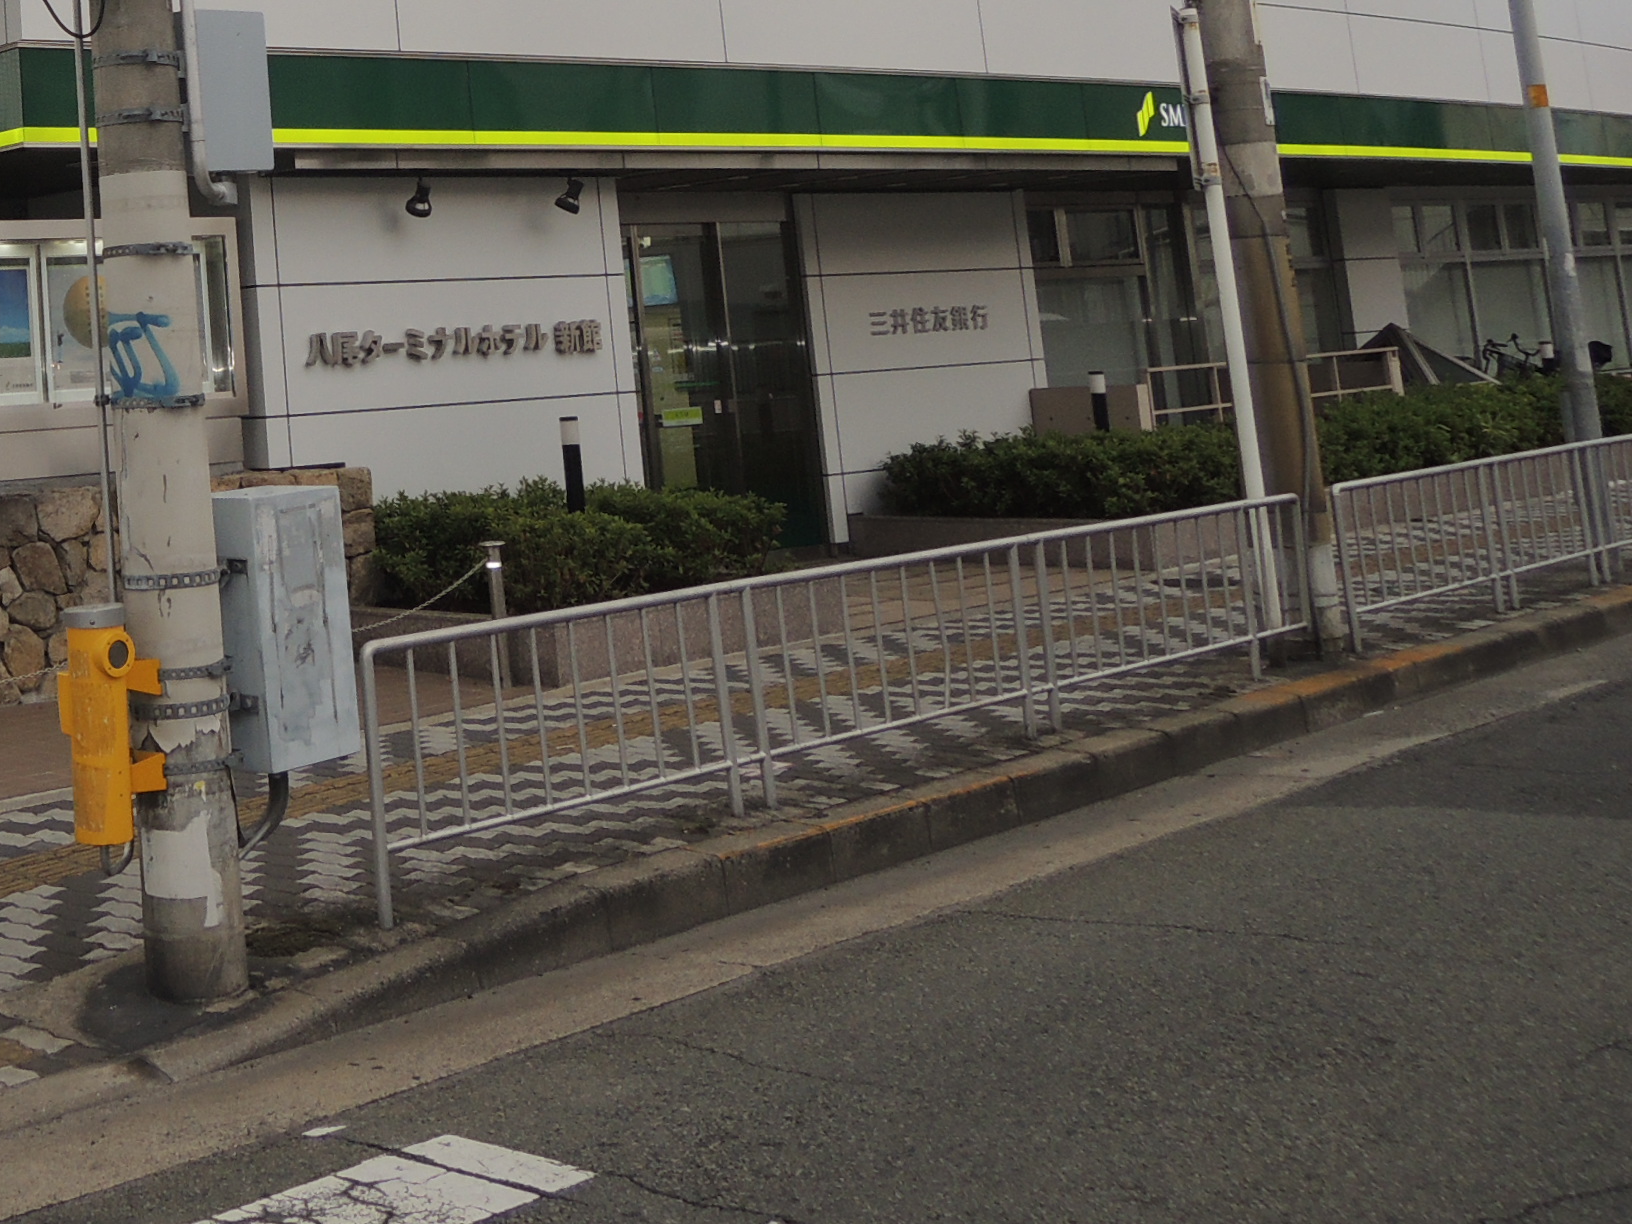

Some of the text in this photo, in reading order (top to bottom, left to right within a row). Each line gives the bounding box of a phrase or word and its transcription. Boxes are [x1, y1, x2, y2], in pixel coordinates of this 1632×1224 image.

[869, 304, 989, 336] 三井住友銀行
[305, 319, 603, 368] 八尾ターミナルホテル 新館
